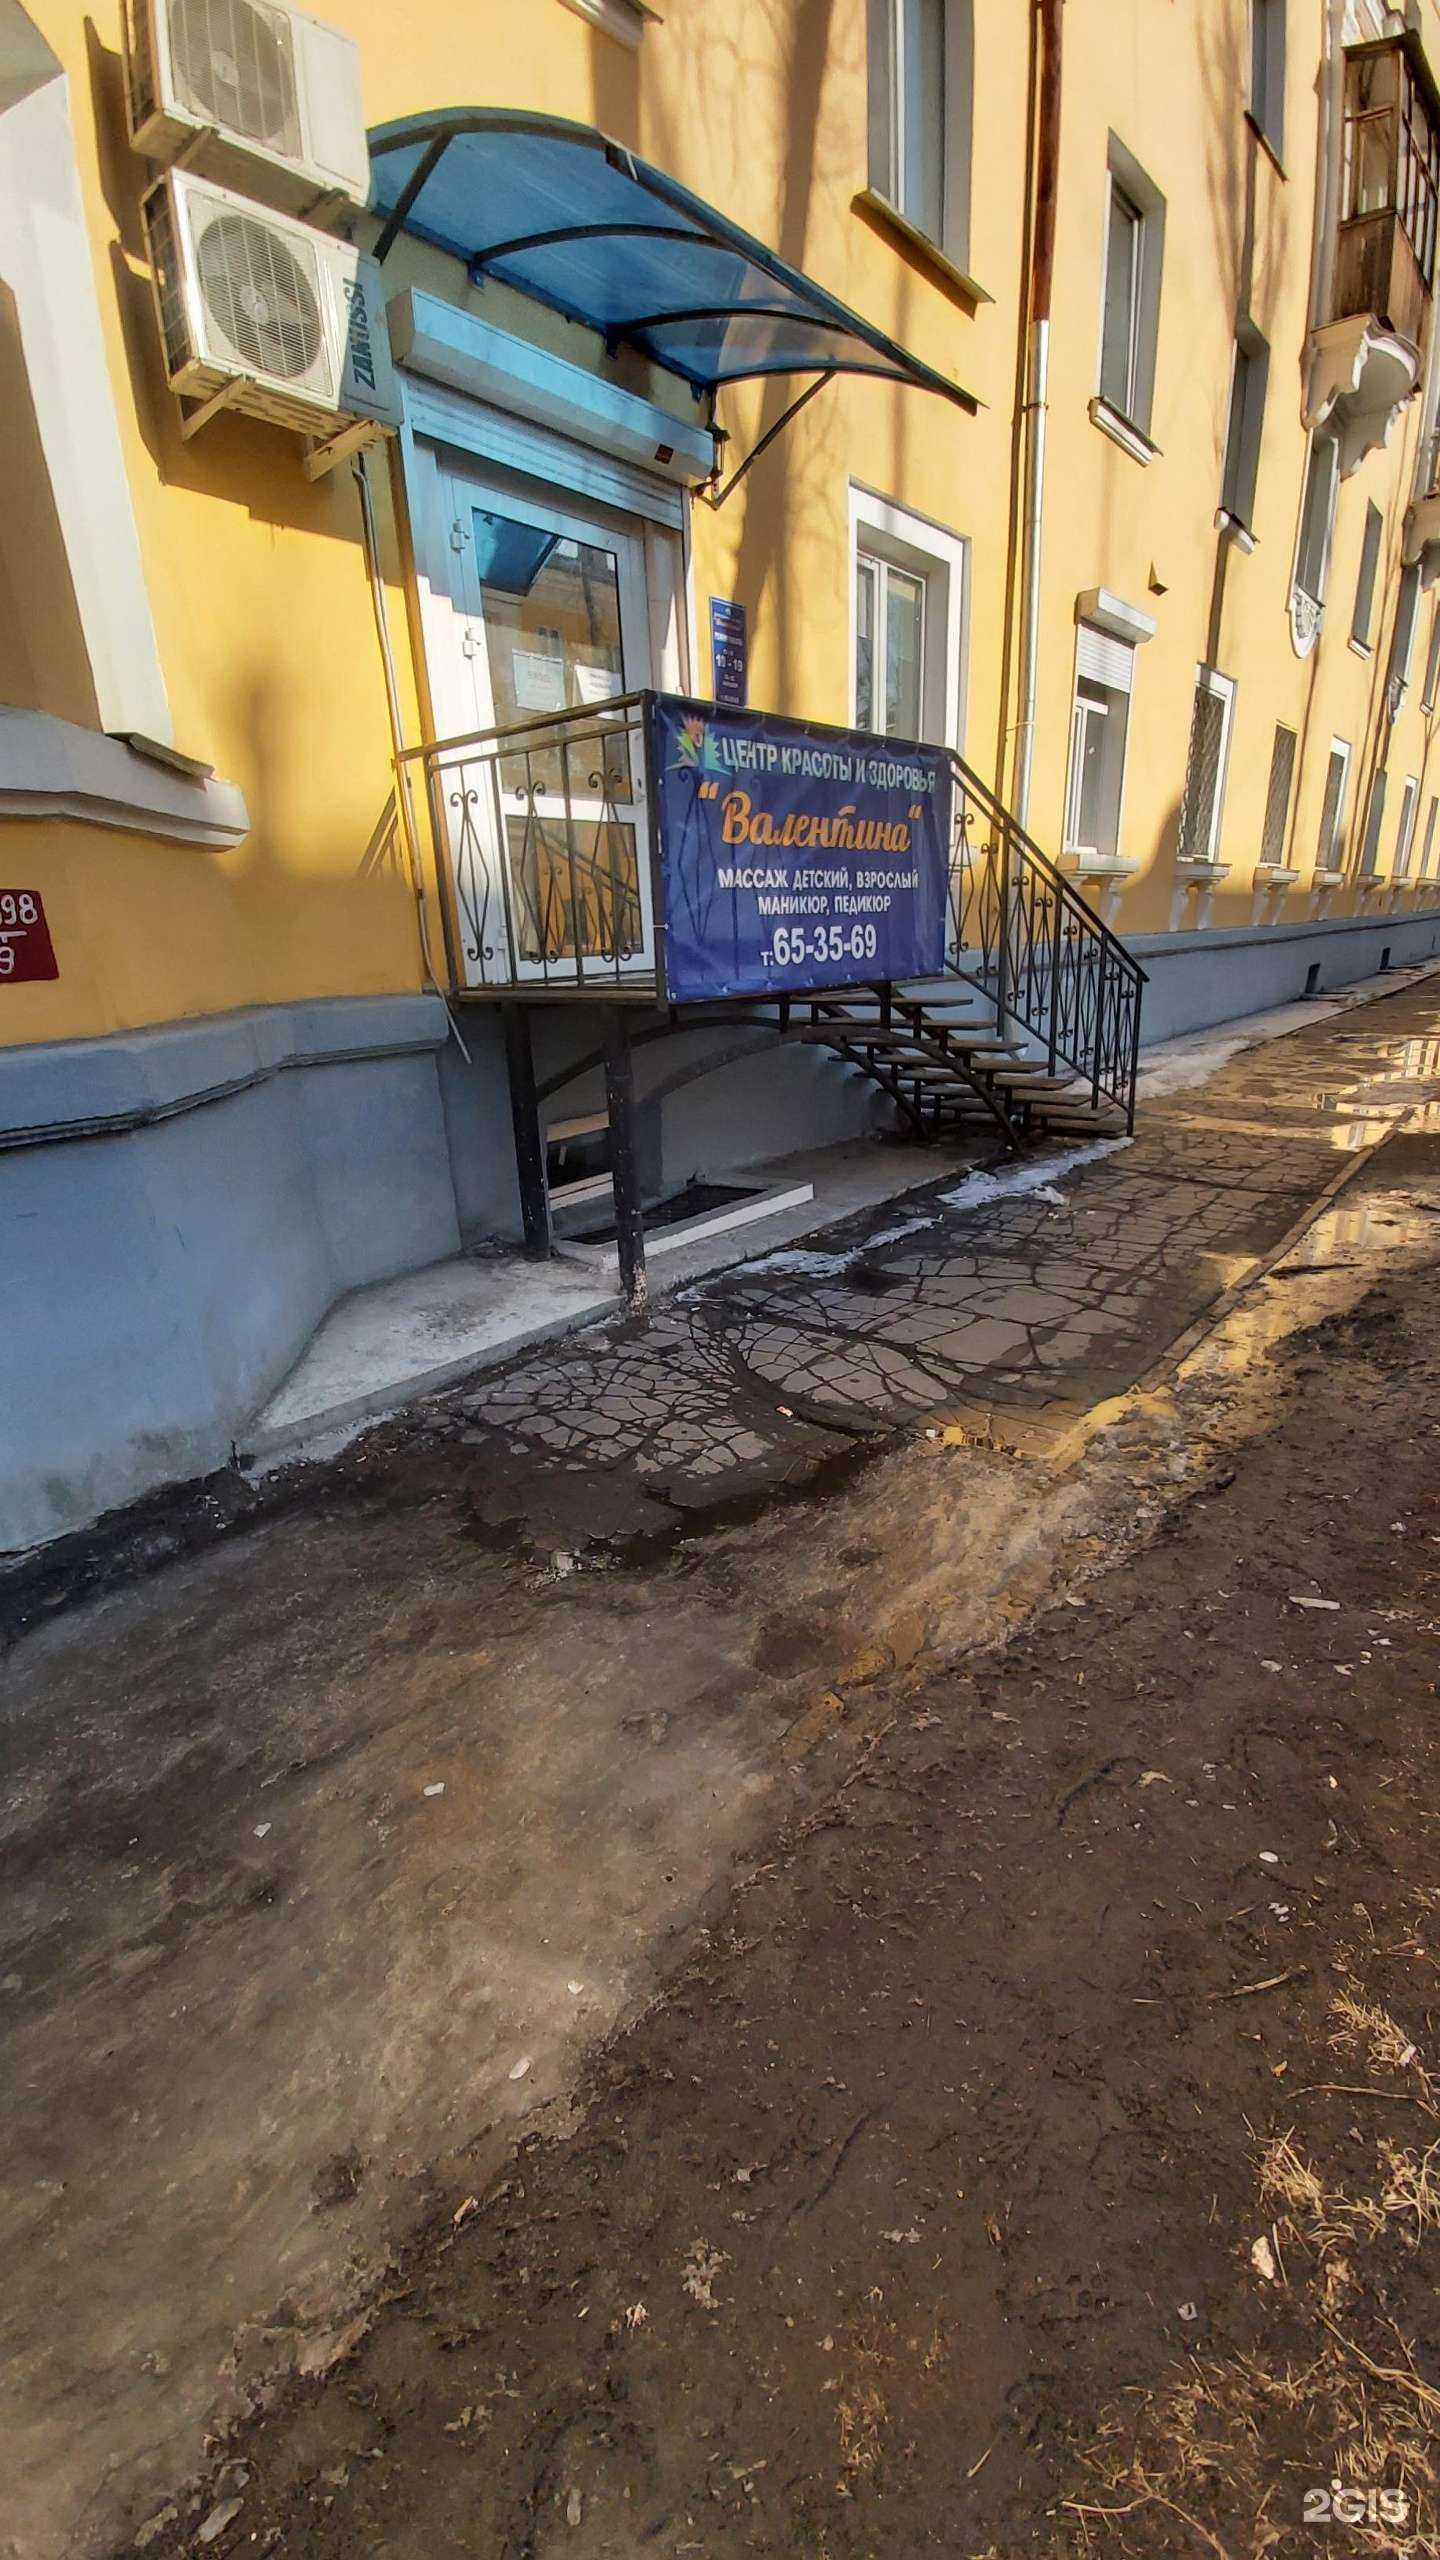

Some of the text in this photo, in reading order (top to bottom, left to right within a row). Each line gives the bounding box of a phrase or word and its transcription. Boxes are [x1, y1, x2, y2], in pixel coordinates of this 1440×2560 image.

[343, 278, 376, 391] ZANUSSI
[722, 737, 936, 793] ЦЕНТР КРАСОТЫ И ЗДОРОВЬЯ
[718, 867, 919, 891] МАССАЖ ДЕТСКИЙ, ВЗРОСЛЫЙ
[0, 893, 38, 925] 98
[758, 895, 891, 916] МАНИКЮР, ПЕДИКЮР
